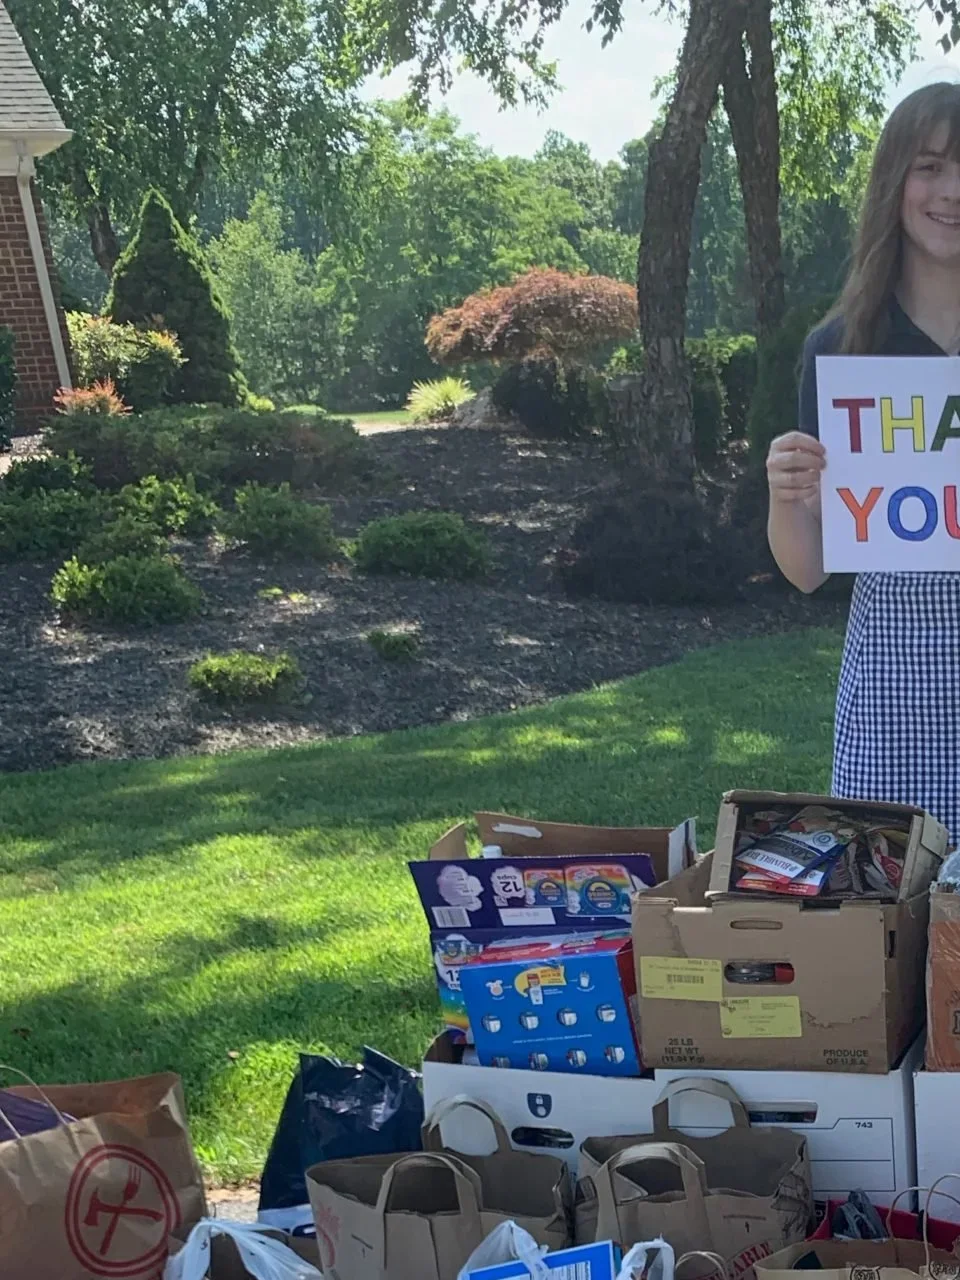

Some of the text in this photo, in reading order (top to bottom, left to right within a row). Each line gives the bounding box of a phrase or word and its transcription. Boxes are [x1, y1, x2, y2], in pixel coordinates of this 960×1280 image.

[501, 880, 522, 893] 12
[681, 1038, 694, 1047] LB
[664, 1047, 700, 1056] NET WT
[823, 1049, 869, 1058] PRODUCE
[827, 1058, 839, 1066] OF
[855, 1121, 874, 1129] 743
